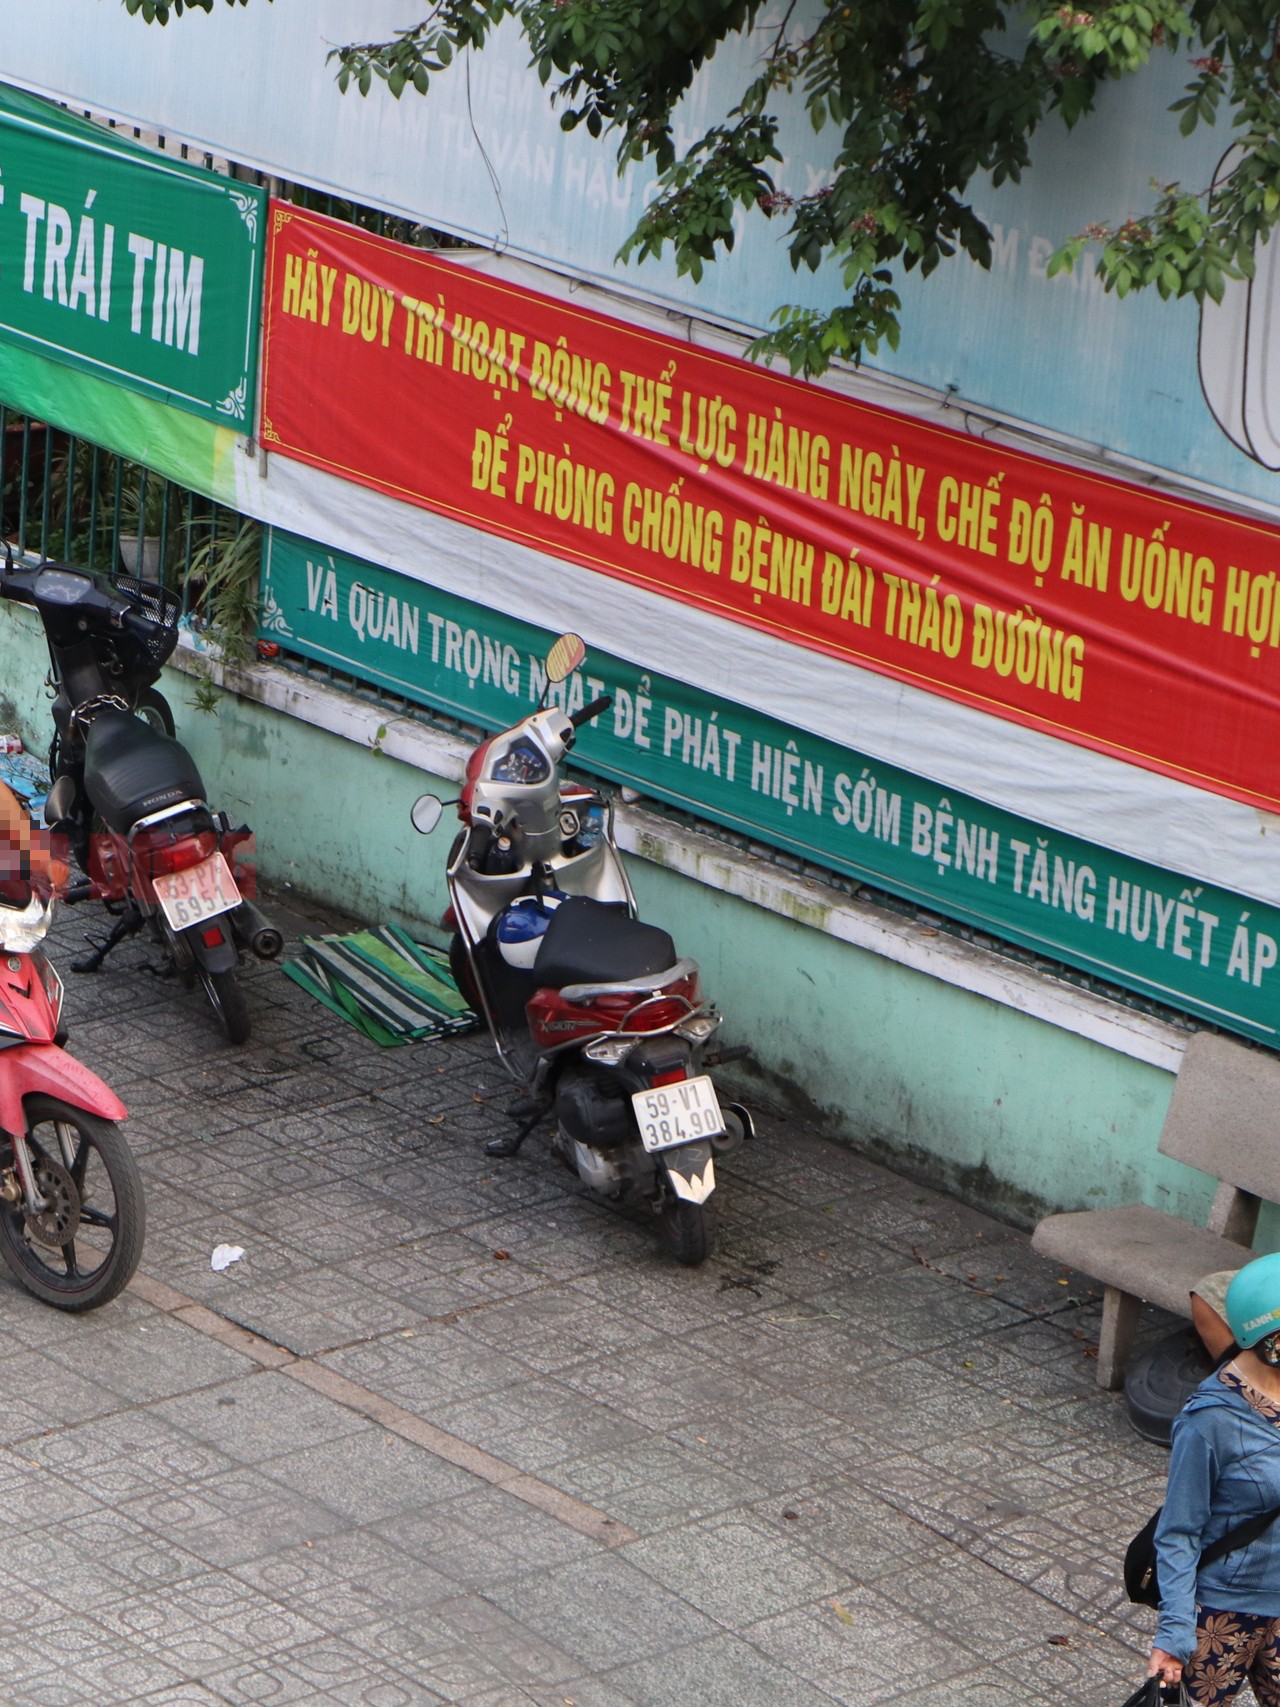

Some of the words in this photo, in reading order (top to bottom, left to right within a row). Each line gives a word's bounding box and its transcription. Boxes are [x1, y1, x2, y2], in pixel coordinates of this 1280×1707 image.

[20, 189, 115, 322] TRÁI
[128, 232, 205, 356] TIM
[282, 248, 336, 327] HÃY
[342, 271, 397, 348] DUY
[401, 293, 446, 367] TRÌ
[451, 313, 525, 400] HOẠT
[529, 338, 612, 425] ĐỘNG
[619, 360, 678, 447] THỂ
[679, 394, 738, 475] LỰC
[743, 407, 830, 501] HÀNG
[838, 444, 926, 541] NGÀY,
[936, 471, 1006, 558] CHẾ
[1008, 493, 1055, 588] ĐỘ
[1061, 501, 1113, 593] ĂN
[1120, 520, 1216, 627] UỐNG
[471, 413, 513, 499] ĐỂ
[516, 442, 616, 538] PHÒNG
[623, 475, 724, 576] CHỐNG
[730, 514, 815, 608] BỆNH
[821, 547, 875, 629] ĐÁI
[883, 573, 964, 660] THÁO
[971, 603, 1086, 703] ĐƯỜNG
[306, 555, 338, 622] VÀ
[427, 612, 520, 698] TRỌNG
[613, 674, 653, 749] ĐỂ
[664, 705, 742, 783] PHÁT
[751, 740, 824, 818] HIỆN
[833, 768, 902, 846] SỚM
[911, 797, 1000, 886] BỆNH
[1010, 836, 1097, 922] TĂNG
[1107, 875, 1220, 968] HUYẾT
[1227, 910, 1279, 988] ÁP
[644, 1084, 702, 1119] 59-V1
[646, 1108, 718, 1147] 384.90
